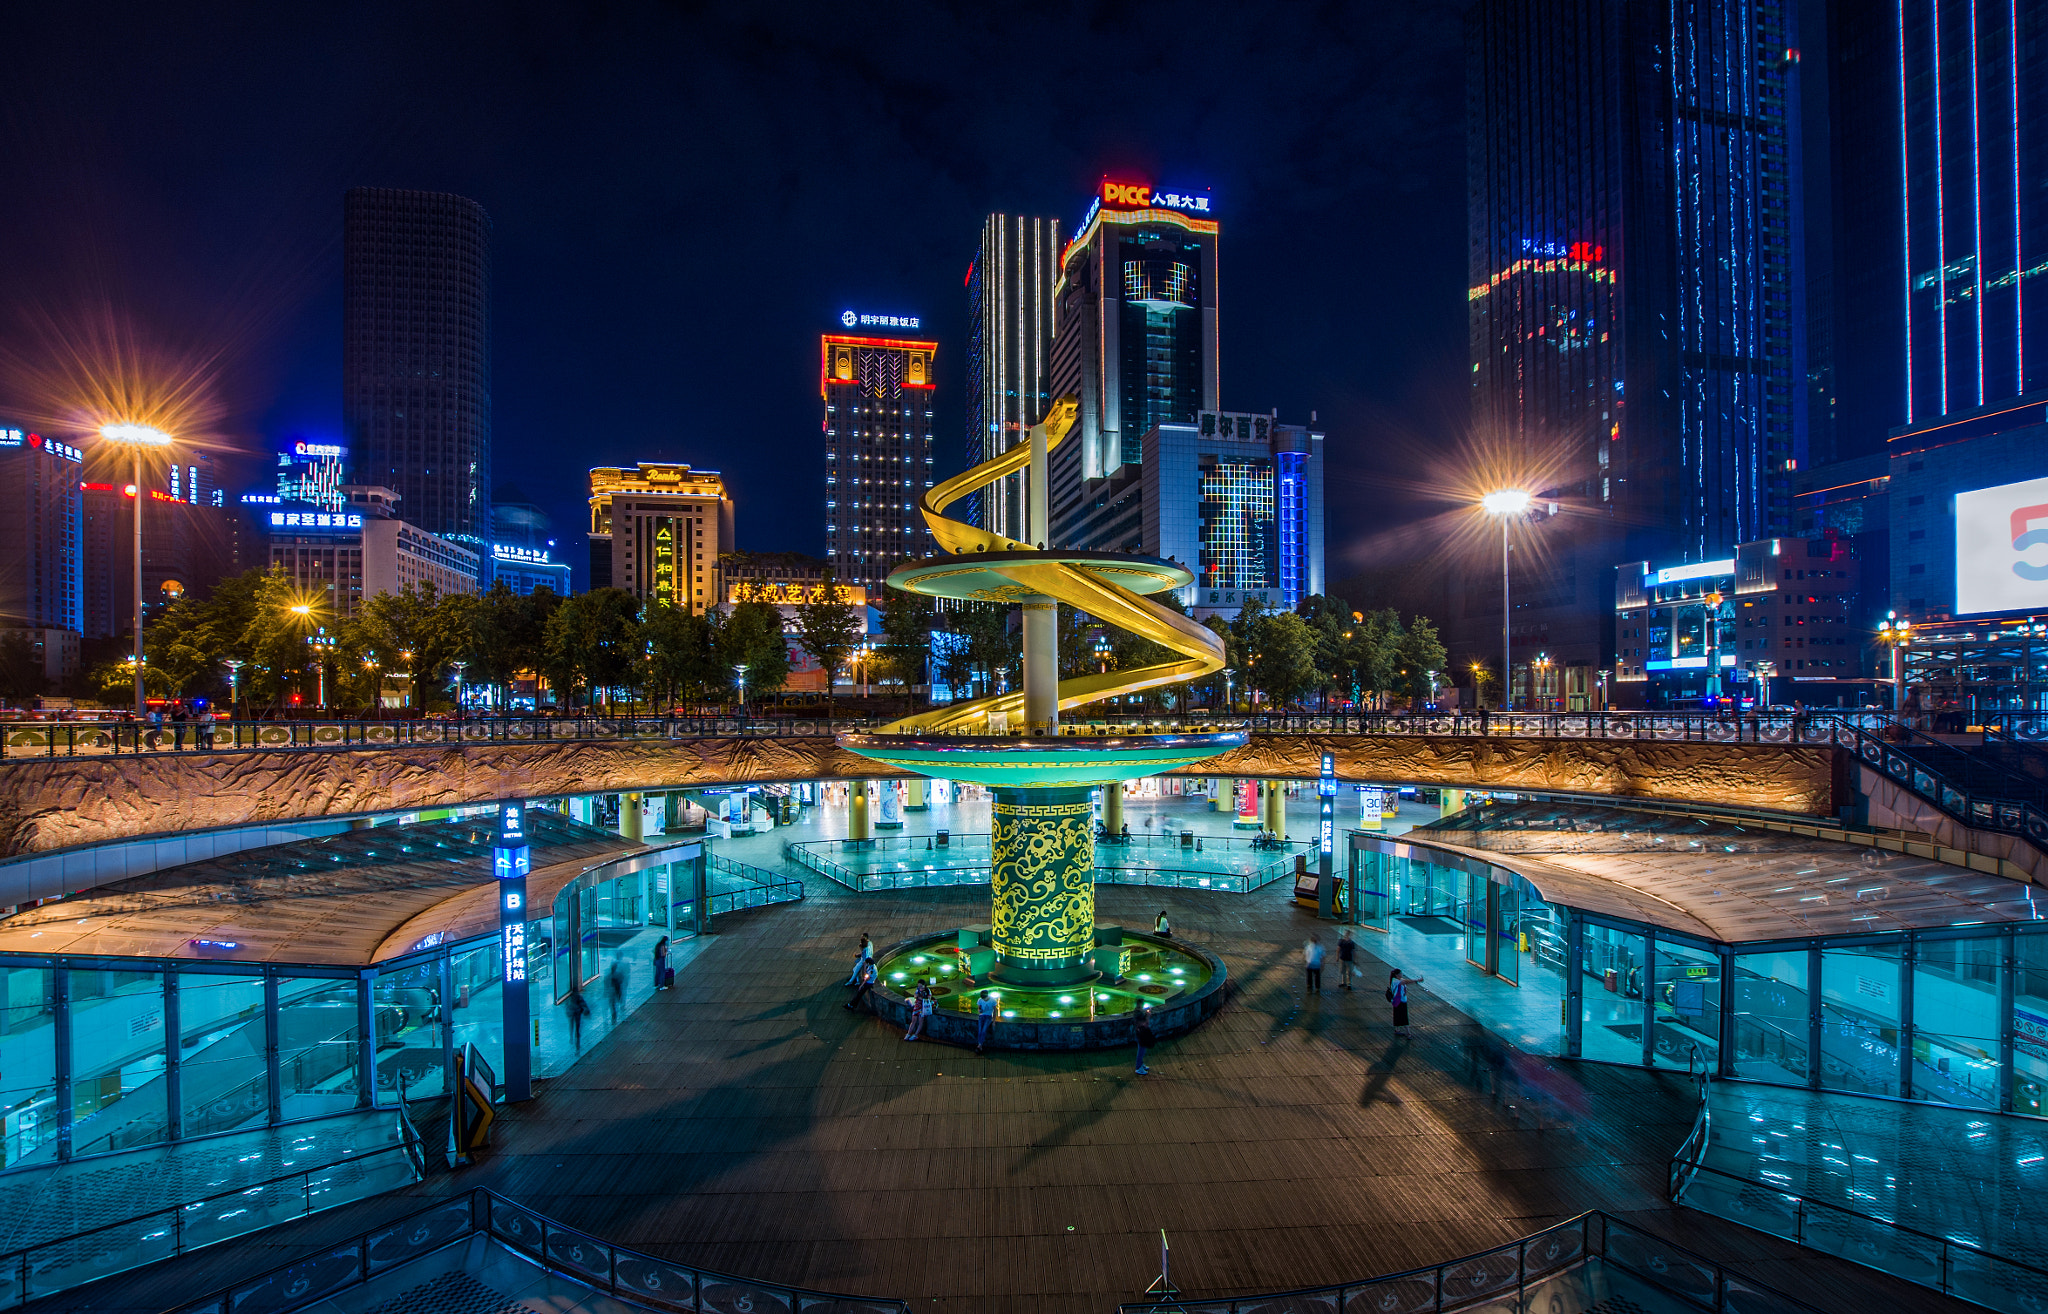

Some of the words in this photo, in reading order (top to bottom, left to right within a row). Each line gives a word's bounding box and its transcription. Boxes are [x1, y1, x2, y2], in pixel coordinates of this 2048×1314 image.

[1104, 183, 1150, 206] PICC
[1151, 192, 1210, 212] 人保大厦
[860, 314, 920, 328] 明宇丽雅饭店
[1201, 413, 1268, 439] 摩尔百货
[1209, 591, 1269, 603] 摩尔百货
[1323, 804, 1331, 813] A
[1366, 798, 1381, 808] 30
[506, 808, 519, 829] 地铁
[506, 893, 521, 909] B
[512, 923, 525, 980] 天府广场站
